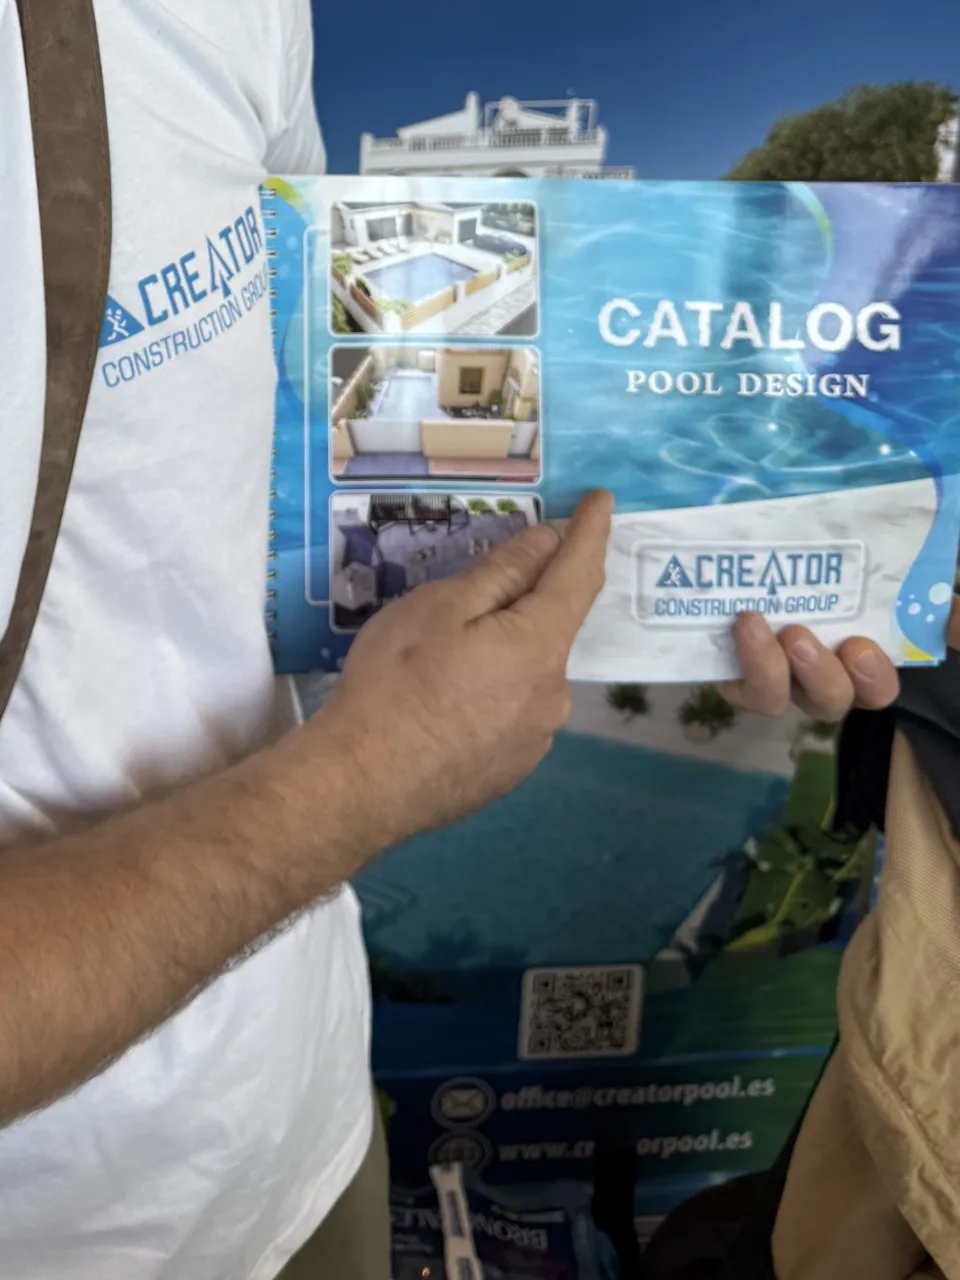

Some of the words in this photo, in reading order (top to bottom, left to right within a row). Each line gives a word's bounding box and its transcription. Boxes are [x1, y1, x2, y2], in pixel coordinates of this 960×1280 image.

[137, 205, 263, 327] CREATOR
[101, 295, 244, 388] CONSTRUCTION
[597, 298, 901, 352] CATALOG
[625, 369, 724, 396] POOL
[736, 371, 870, 399] DESIGN
[695, 549, 844, 596] CREATOR
[653, 596, 781, 617] CONSTRUCTION
[784, 593, 840, 614] GROUP
[500, 1075, 776, 1113] office@creatorpool.es
[497, 1128, 754, 1163] www.crorpool.es
